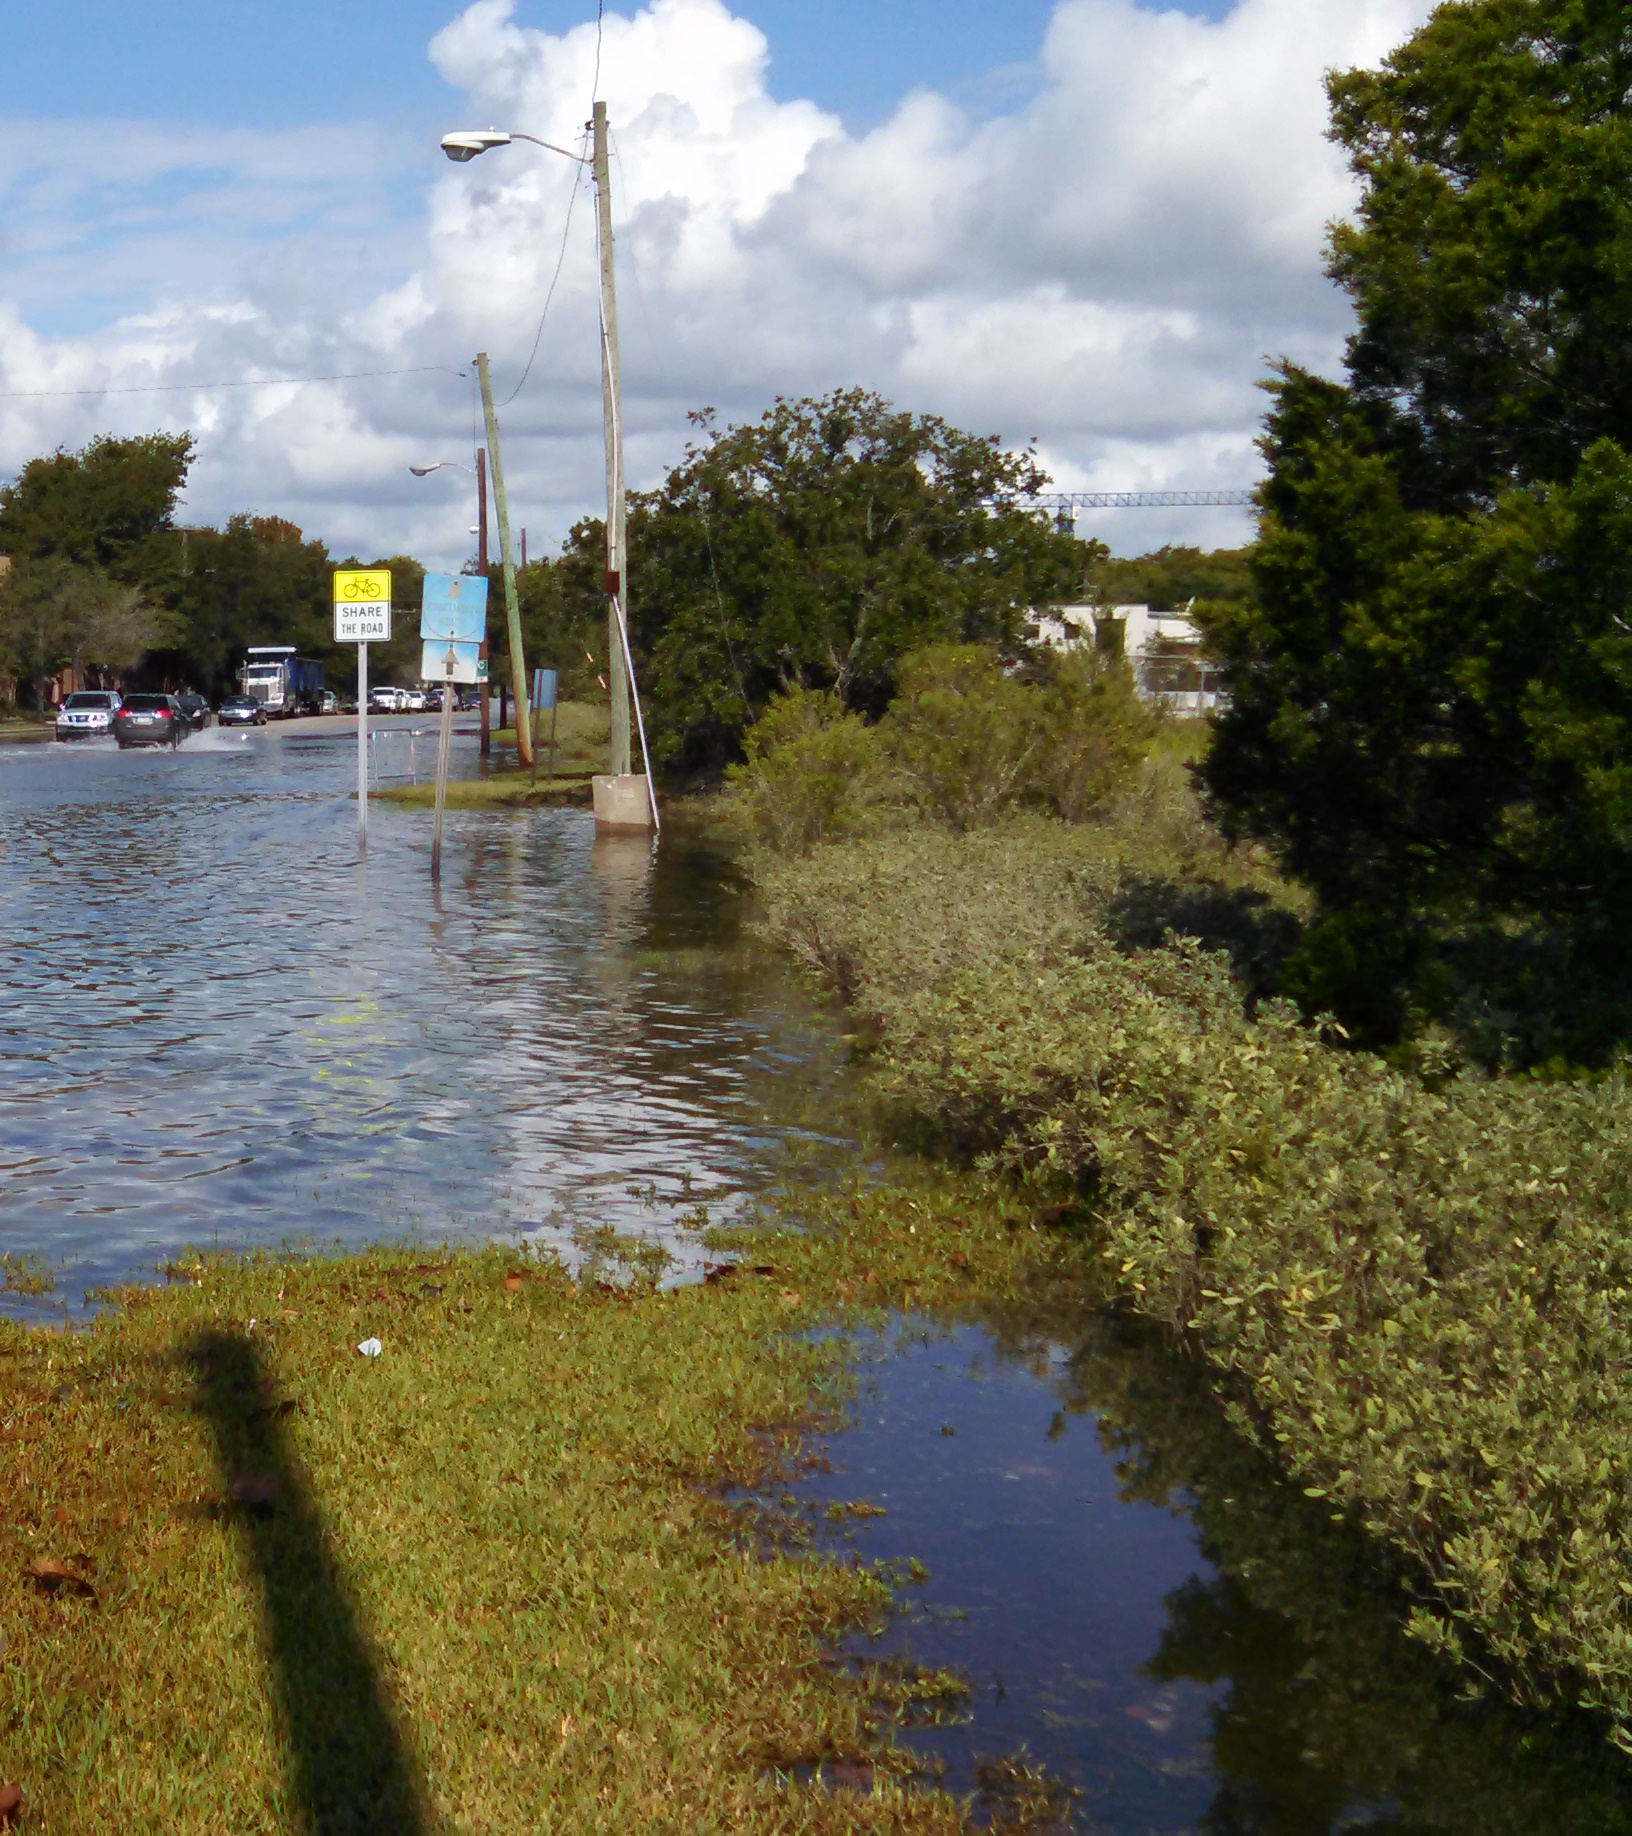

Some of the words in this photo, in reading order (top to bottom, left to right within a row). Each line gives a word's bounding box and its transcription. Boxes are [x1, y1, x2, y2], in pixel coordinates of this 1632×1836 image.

[342, 606, 383, 618] SHARE
[341, 623, 357, 634] THE
[360, 622, 384, 635] ROAD
